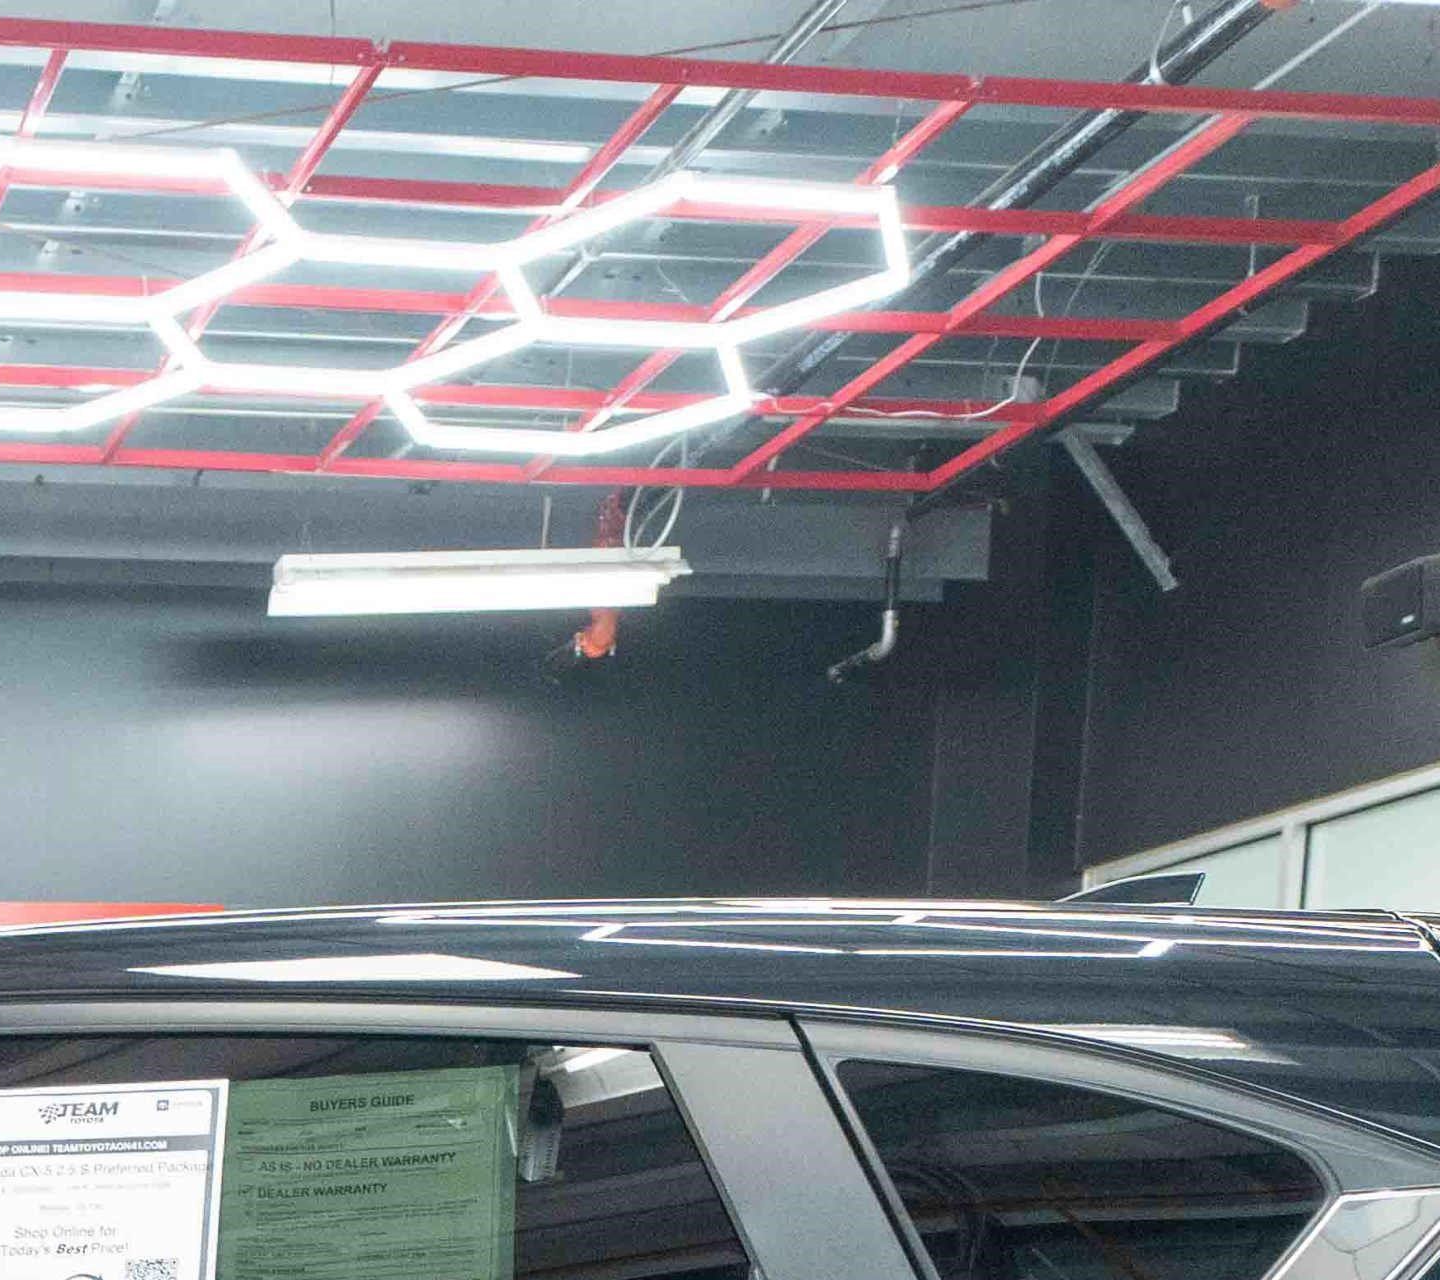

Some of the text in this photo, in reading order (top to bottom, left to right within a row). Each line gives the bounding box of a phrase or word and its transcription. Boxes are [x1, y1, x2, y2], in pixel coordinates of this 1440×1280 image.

[57, 1101, 119, 1117] TEAM
[309, 1094, 415, 1112] BUYERS GUIDE
[69, 1116, 104, 1125] TOYOTA
[94, 1161, 154, 1174] Preferred
[258, 1161, 276, 1172] AS
[280, 1160, 292, 1171] IS
[303, 1160, 322, 1171] NO
[326, 1157, 378, 1170] DEALER
[381, 1151, 456, 1167] WARRANTY
[257, 1183, 388, 1199] DEALER WARRANTY
[13, 1224, 117, 1240] Shop Online for
[0, 1242, 129, 1257] Today's Best Price!
